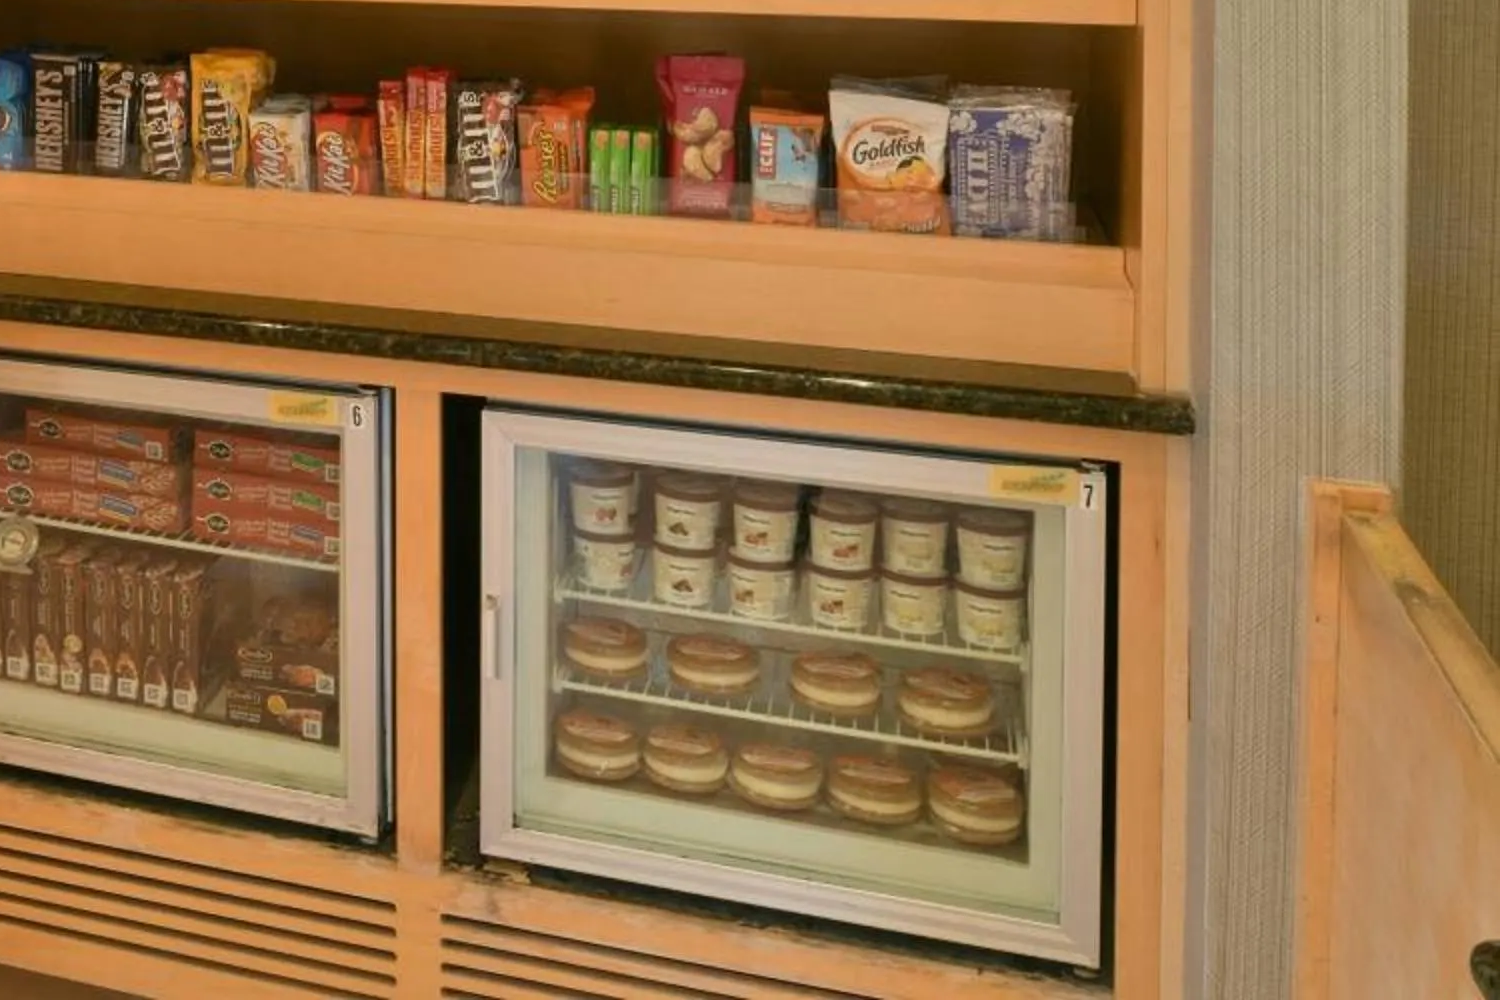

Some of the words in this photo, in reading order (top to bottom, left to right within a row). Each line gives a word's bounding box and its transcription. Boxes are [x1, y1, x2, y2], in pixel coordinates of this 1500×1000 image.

[35, 67, 64, 171] HERSHEY'S
[853, 135, 925, 164] Goldfish
[352, 405, 362, 427] 6
[1083, 484, 1093, 508] 7
